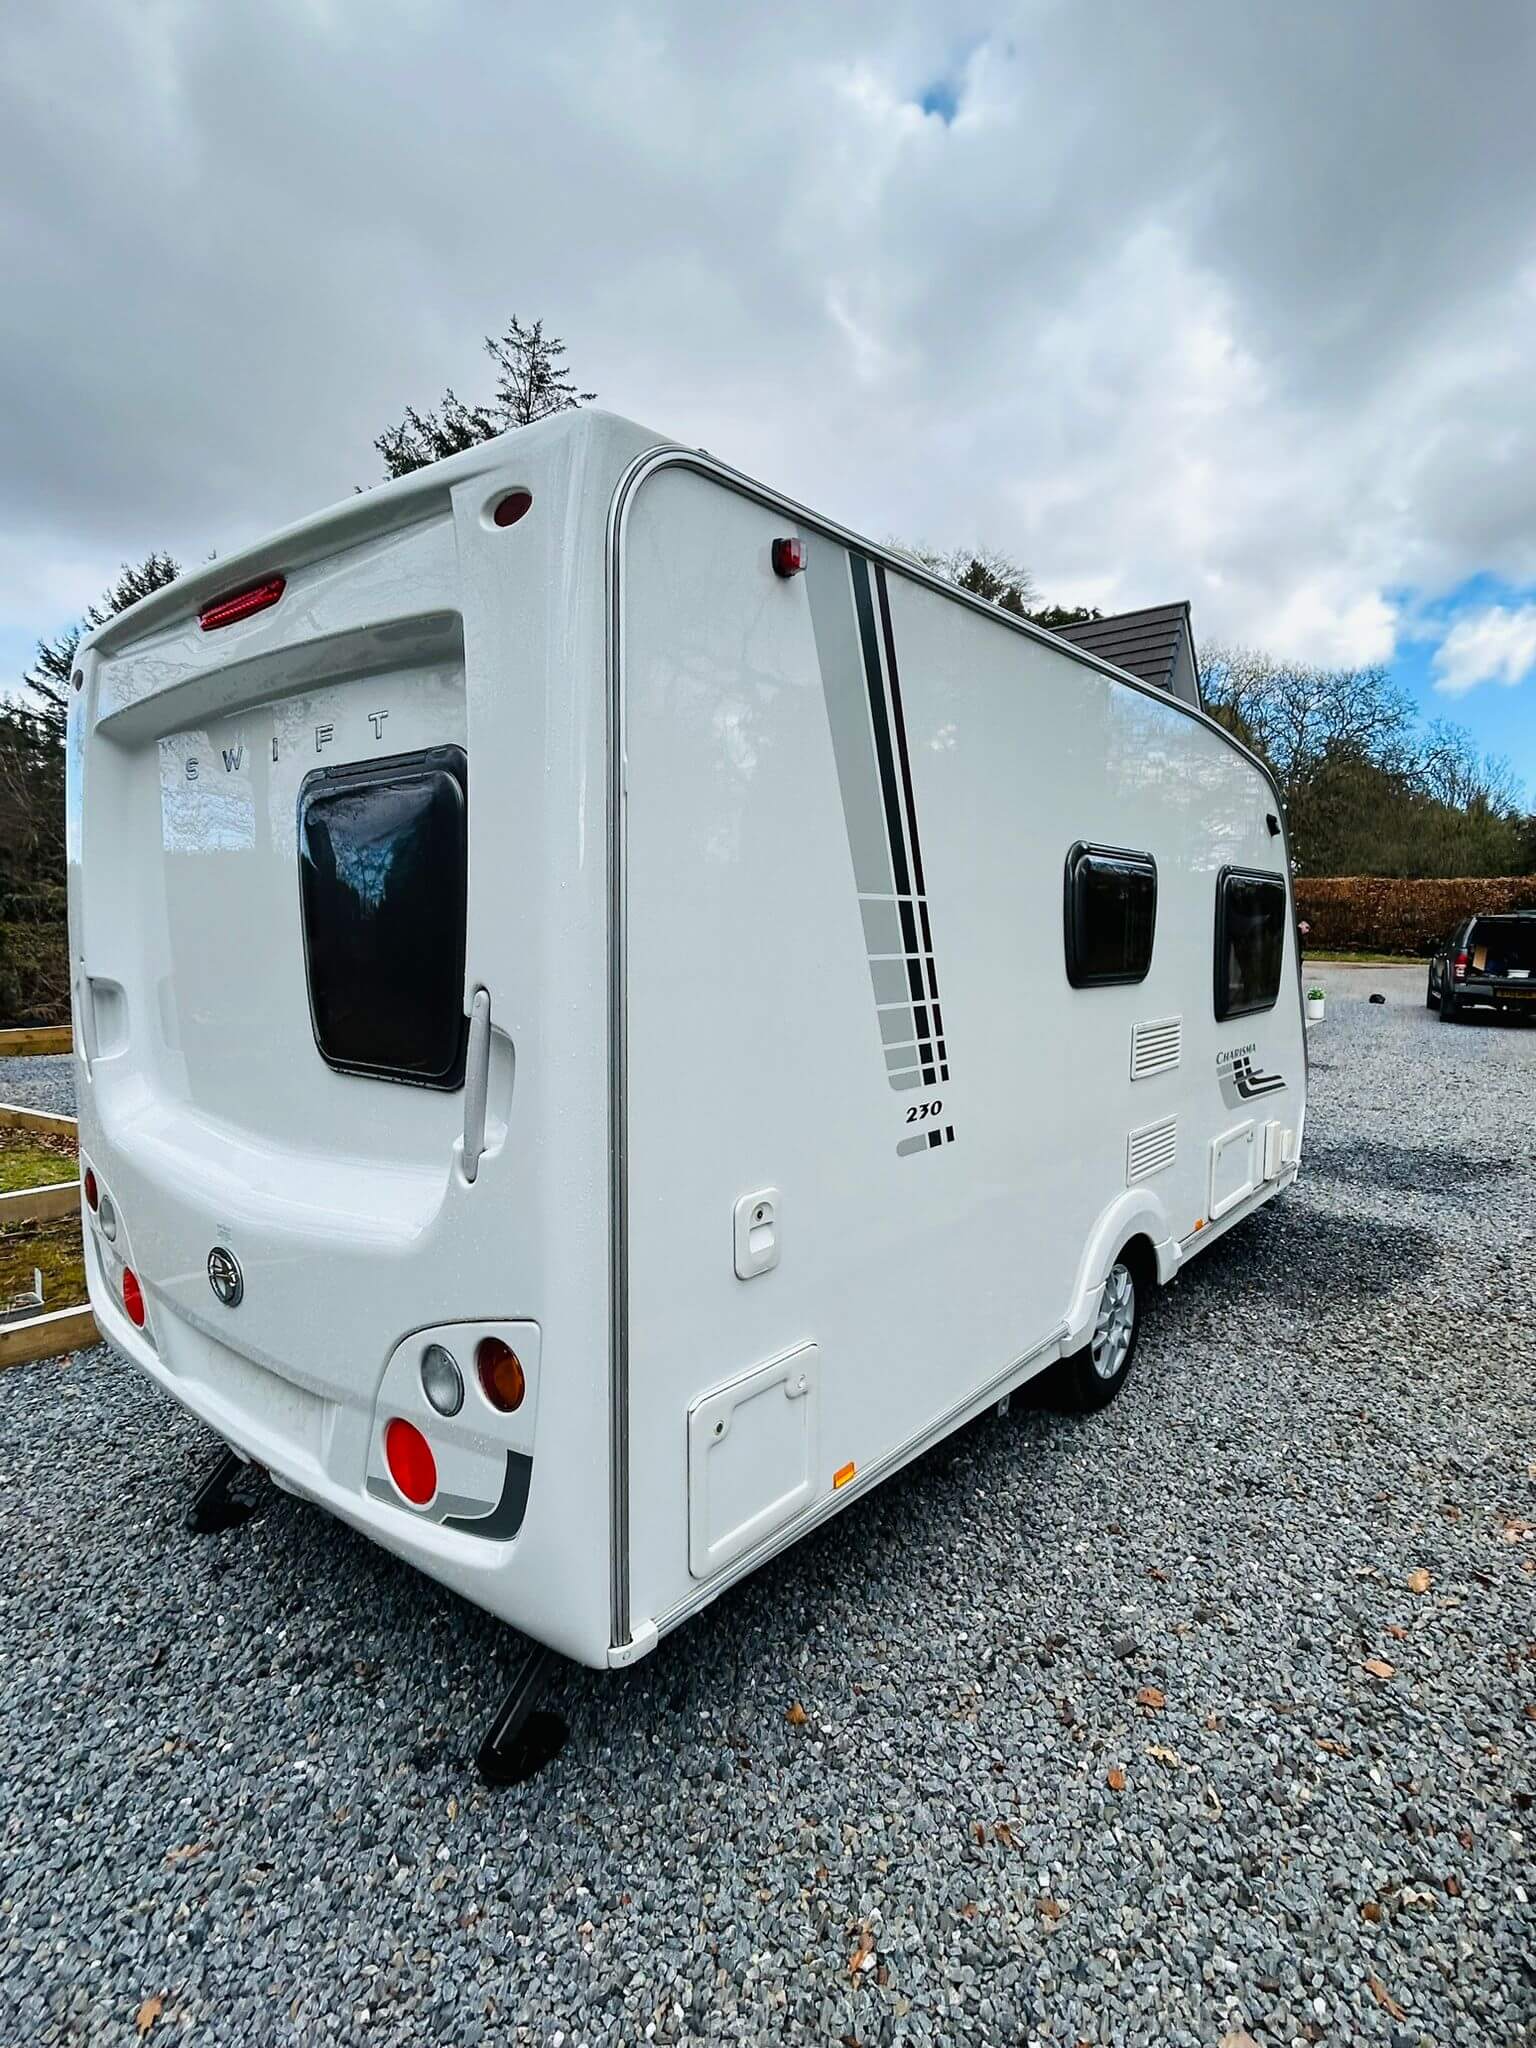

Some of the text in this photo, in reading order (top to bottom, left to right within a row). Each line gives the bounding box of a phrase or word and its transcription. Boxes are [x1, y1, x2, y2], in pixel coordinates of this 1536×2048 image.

[185, 710, 389, 781] SWIFT
[1216, 1043, 1256, 1064] CHARISMA
[905, 1100, 943, 1124] 230
